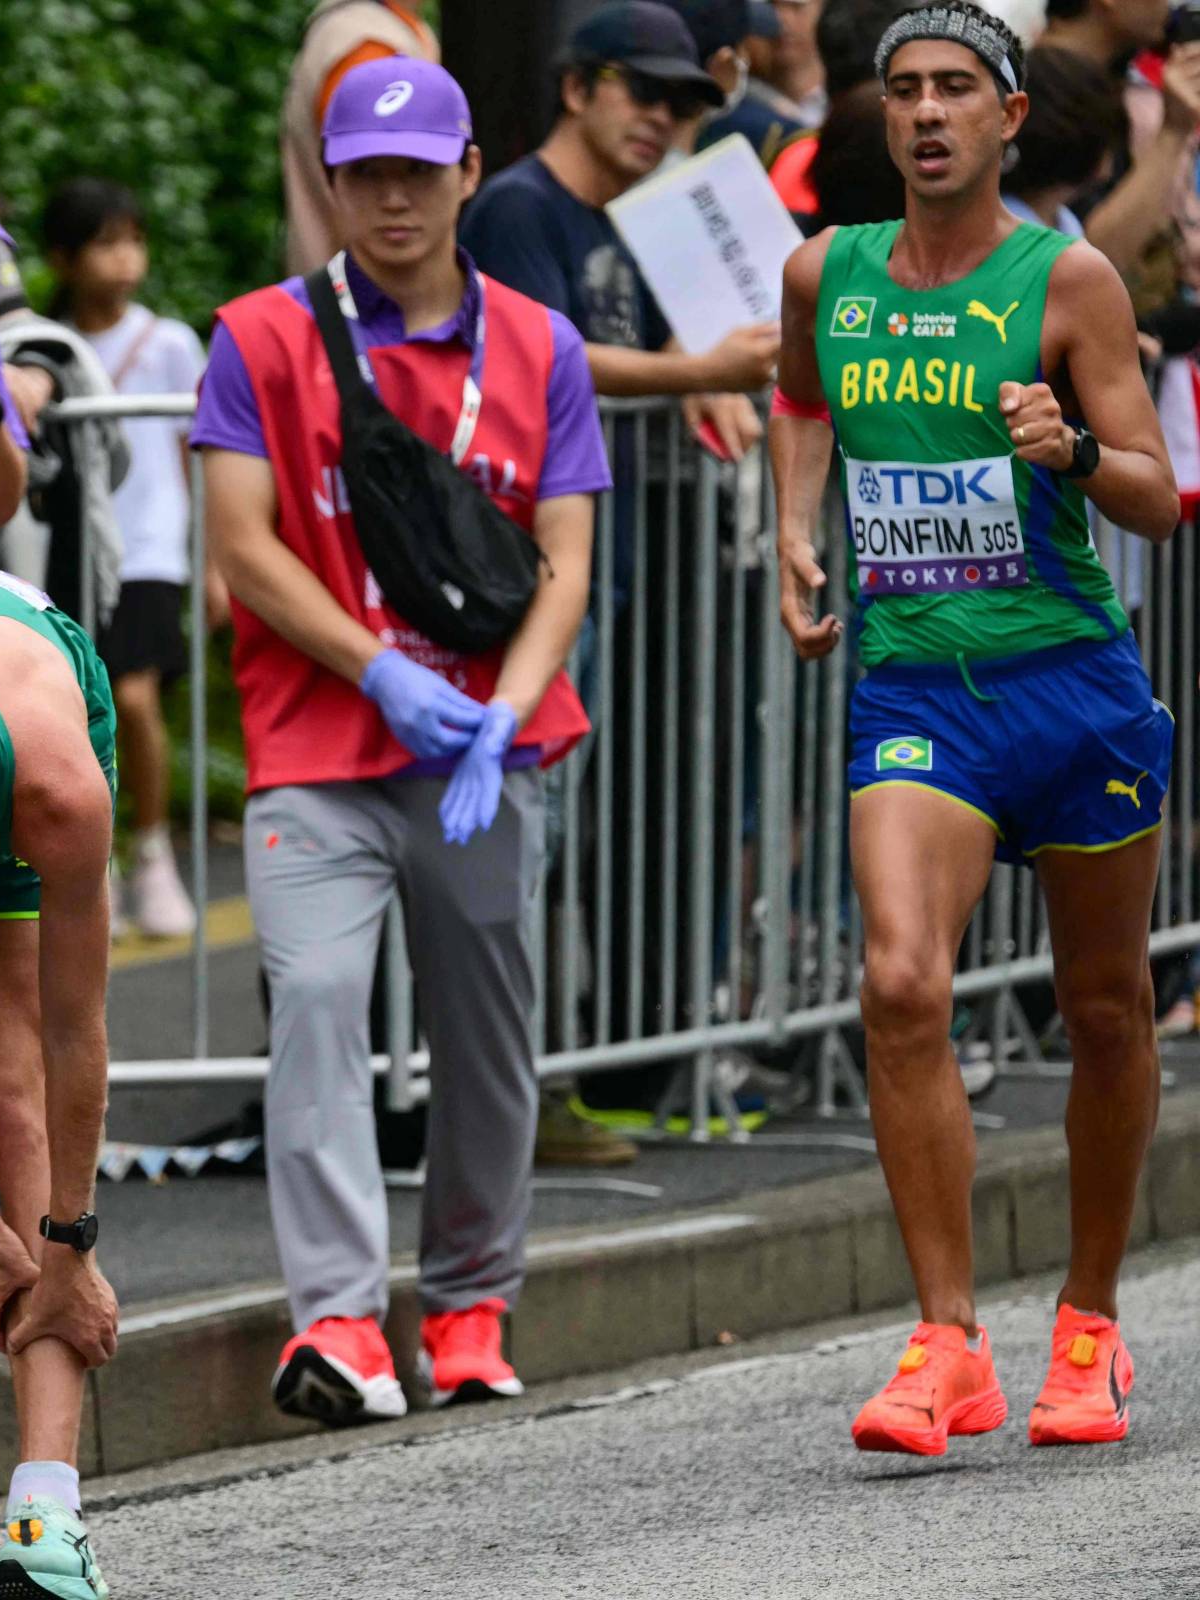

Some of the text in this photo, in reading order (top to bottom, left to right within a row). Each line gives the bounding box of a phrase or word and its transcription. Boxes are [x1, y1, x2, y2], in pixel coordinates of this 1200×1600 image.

[912, 312, 957, 324] loterias
[912, 324, 956, 337] CAIXA
[841, 358, 984, 413] BRASIL
[879, 464, 998, 505] TDK
[855, 516, 1018, 556] BONFIM 305
